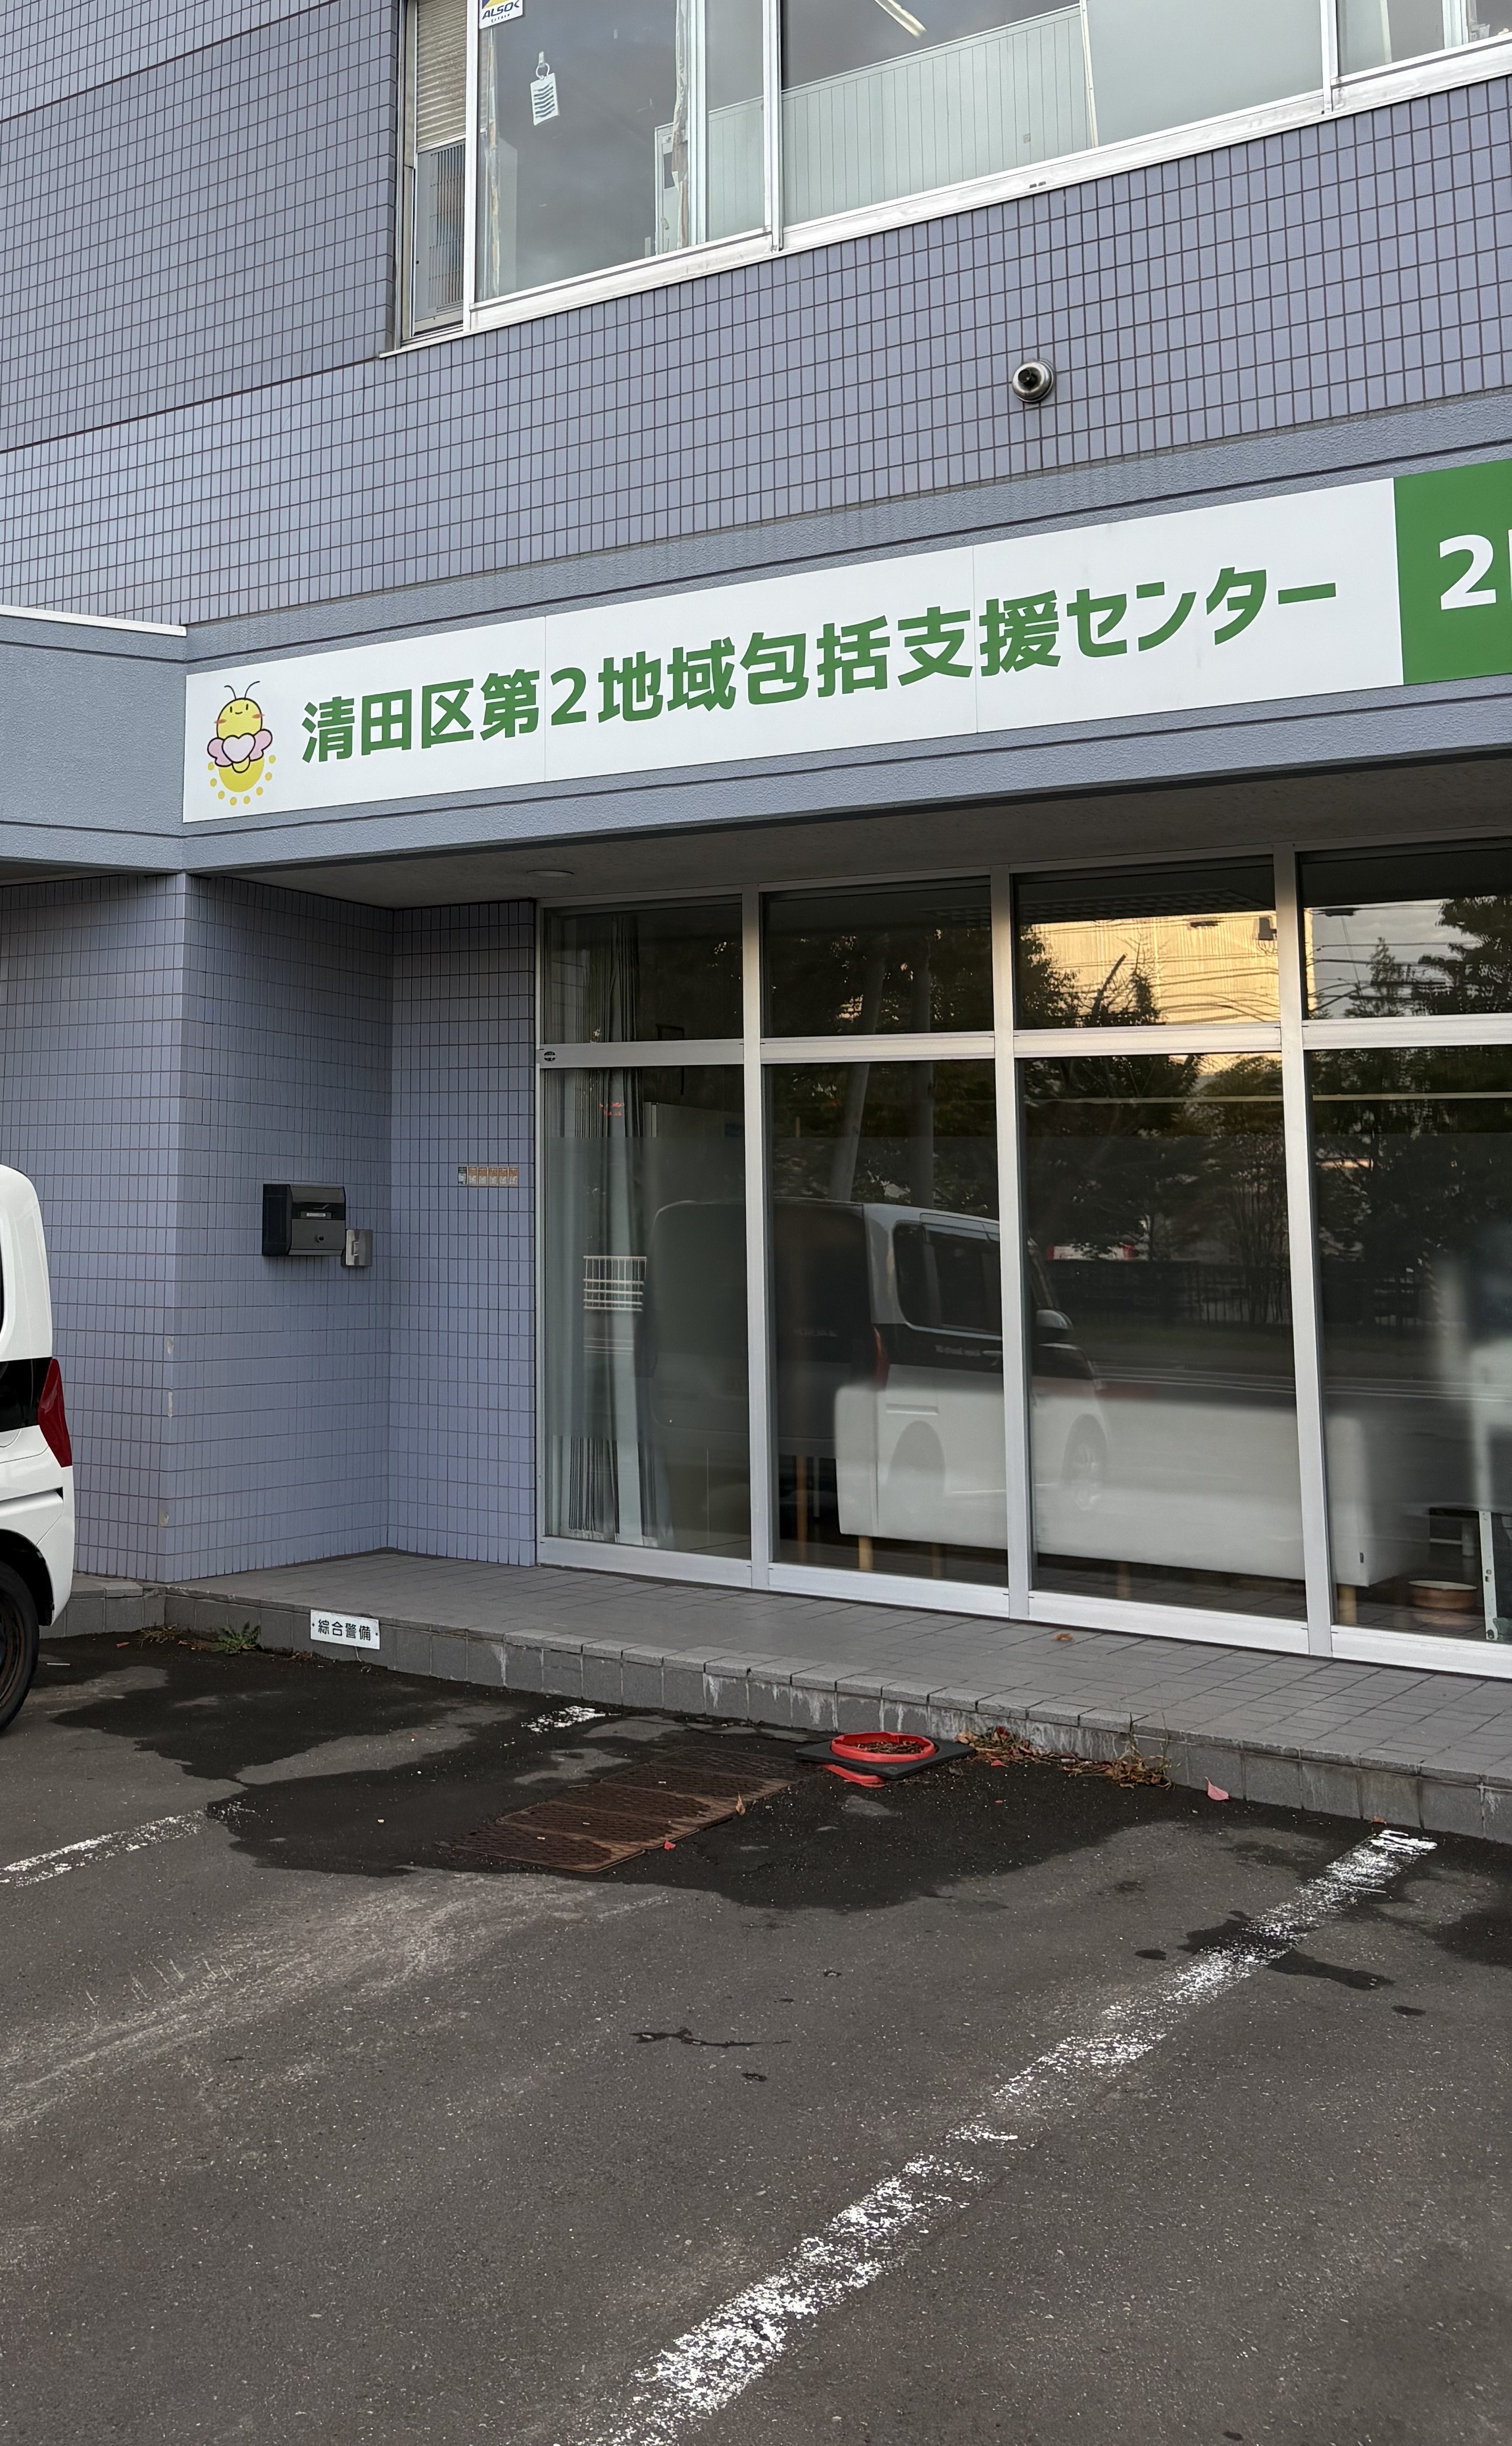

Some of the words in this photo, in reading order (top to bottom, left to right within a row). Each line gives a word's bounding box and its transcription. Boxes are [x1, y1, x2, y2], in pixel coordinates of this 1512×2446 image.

[482, 0, 520, 20] ALSOK
[1438, 529, 1512, 611] 2
[302, 567, 1336, 763] 清田区第2地域包括支援センター
[318, 1619, 371, 1641] 綜合警備
